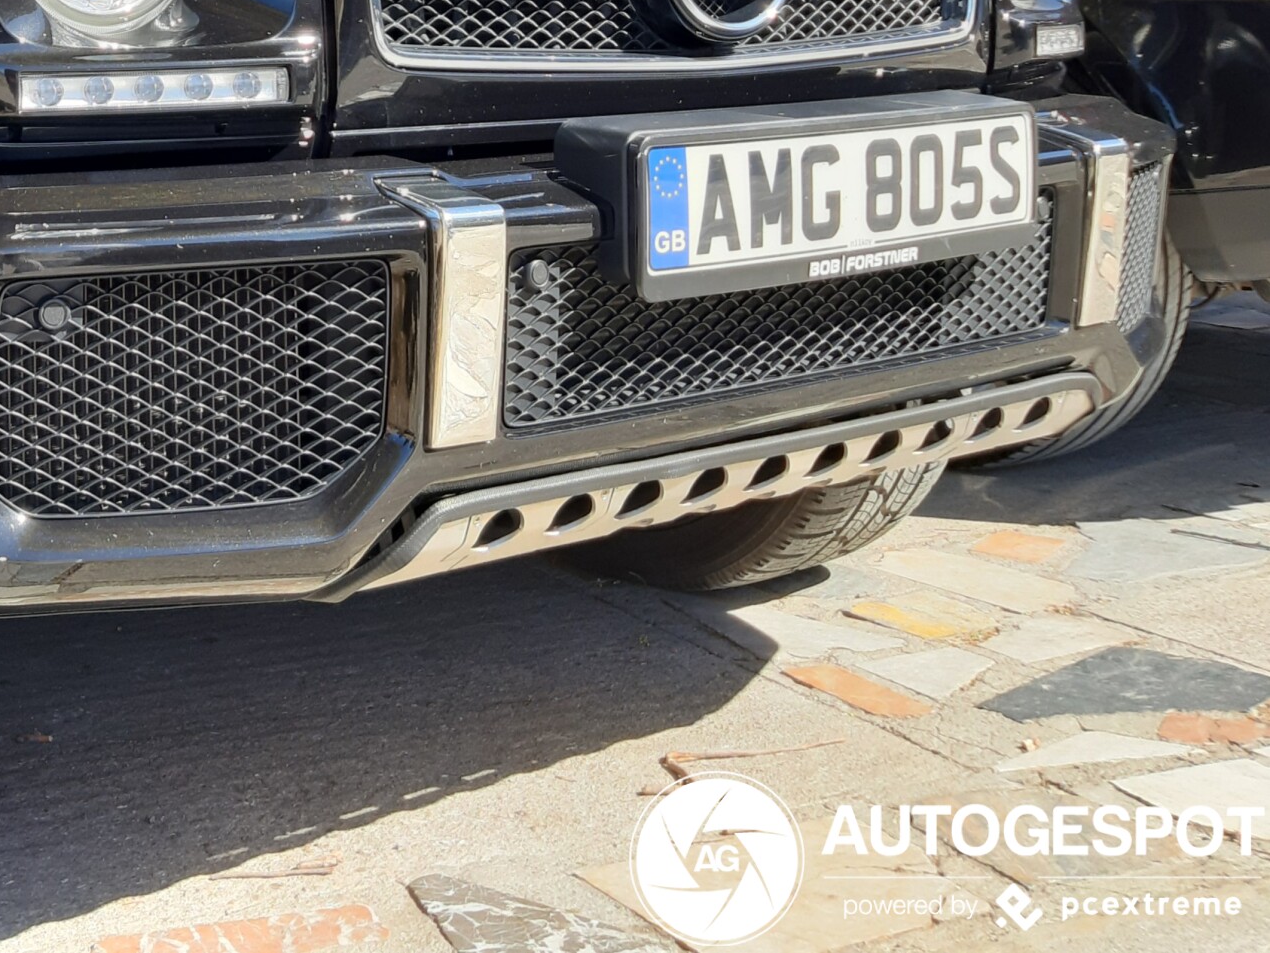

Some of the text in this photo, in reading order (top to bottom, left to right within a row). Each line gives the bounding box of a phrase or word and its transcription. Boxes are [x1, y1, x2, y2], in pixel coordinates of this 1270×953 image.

[696, 125, 1020, 255] AMG 805S
[654, 230, 686, 254] GB
[846, 247, 919, 272] FORSTNER
